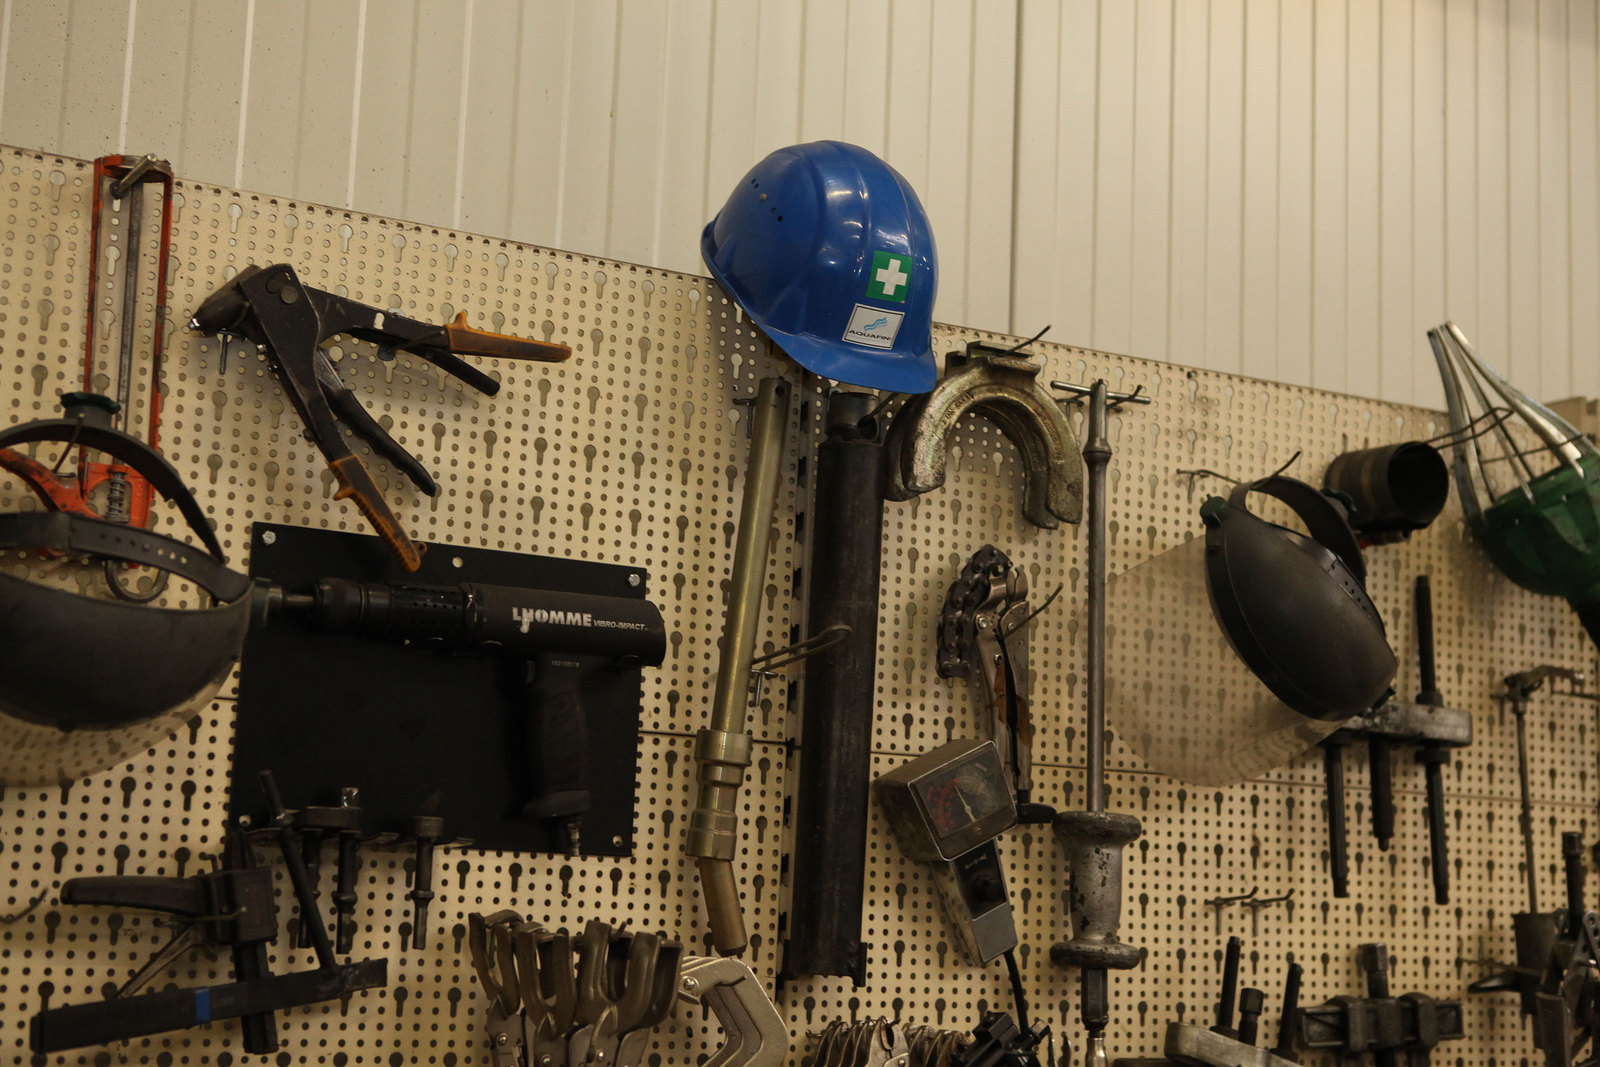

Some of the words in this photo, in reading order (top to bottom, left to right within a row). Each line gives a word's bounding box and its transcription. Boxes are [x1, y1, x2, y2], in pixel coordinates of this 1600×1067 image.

[848, 329, 890, 341] AQUAFIN
[512, 606, 592, 628] LHOMME
[593, 619, 646, 631] VIBRO-IMPACT
